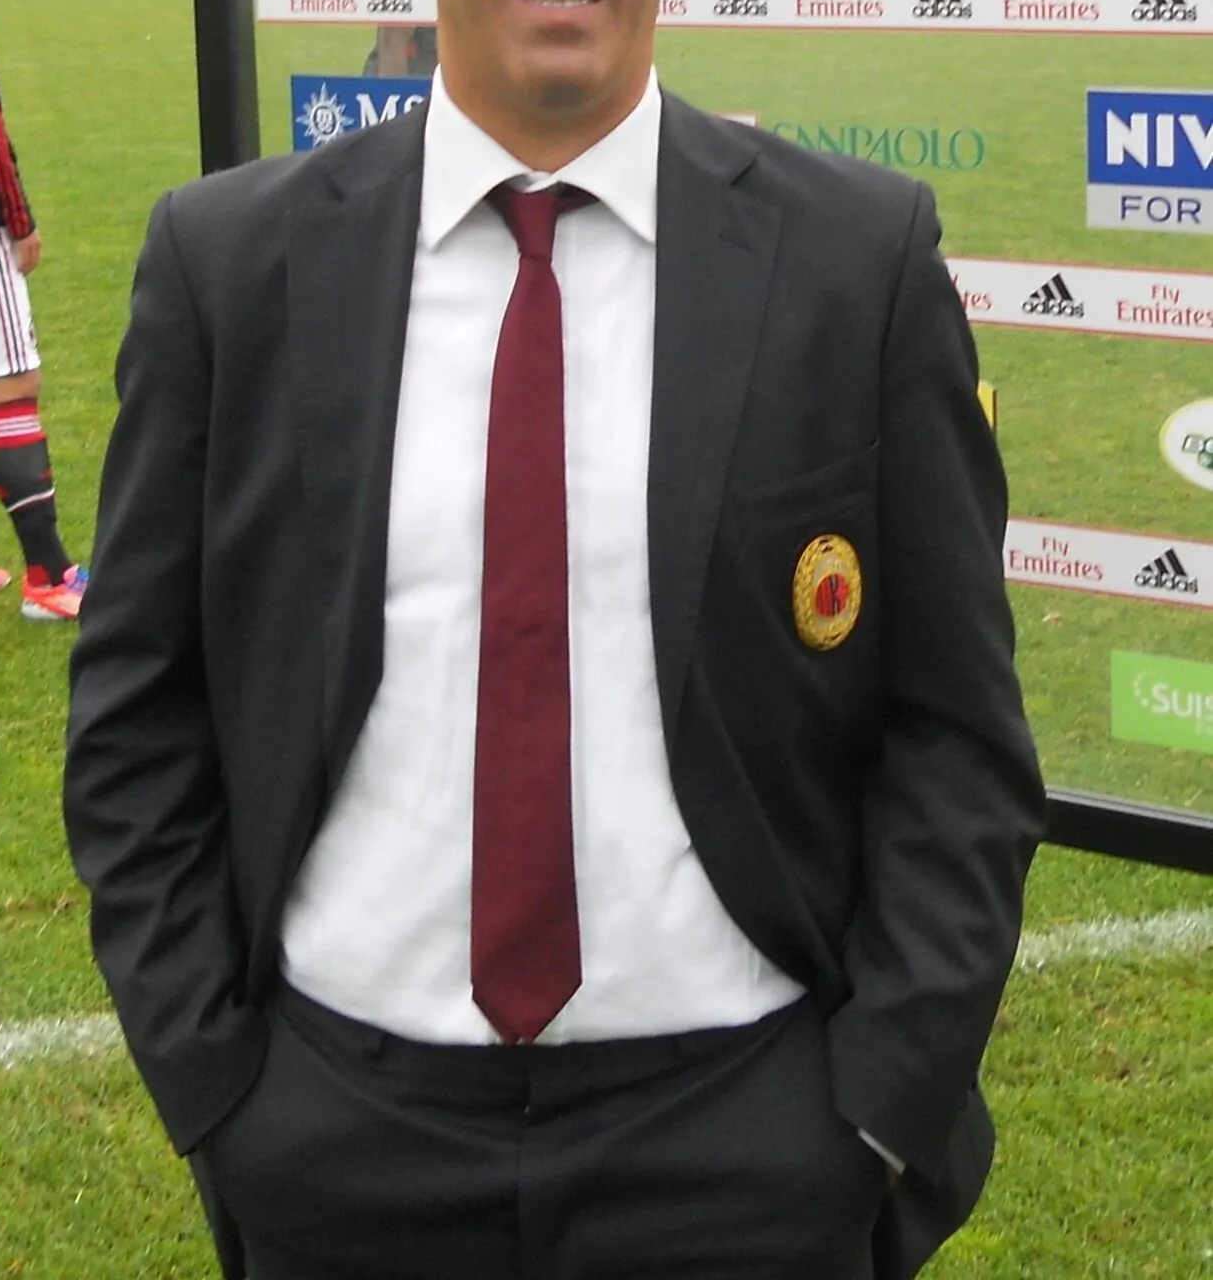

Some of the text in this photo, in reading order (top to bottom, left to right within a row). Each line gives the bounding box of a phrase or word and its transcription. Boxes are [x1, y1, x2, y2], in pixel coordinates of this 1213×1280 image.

[713, 0, 768, 15] adidas
[913, 3, 972, 18] adidas
[1131, 5, 1198, 22] adidas
[1120, 195, 1202, 224] FOR
[1152, 284, 1180, 303] Fly
[1022, 300, 1084, 318] adidas
[1042, 536, 1069, 556] Fly
[1009, 549, 1104, 582] Emirates
[1135, 573, 1199, 594] adidas
